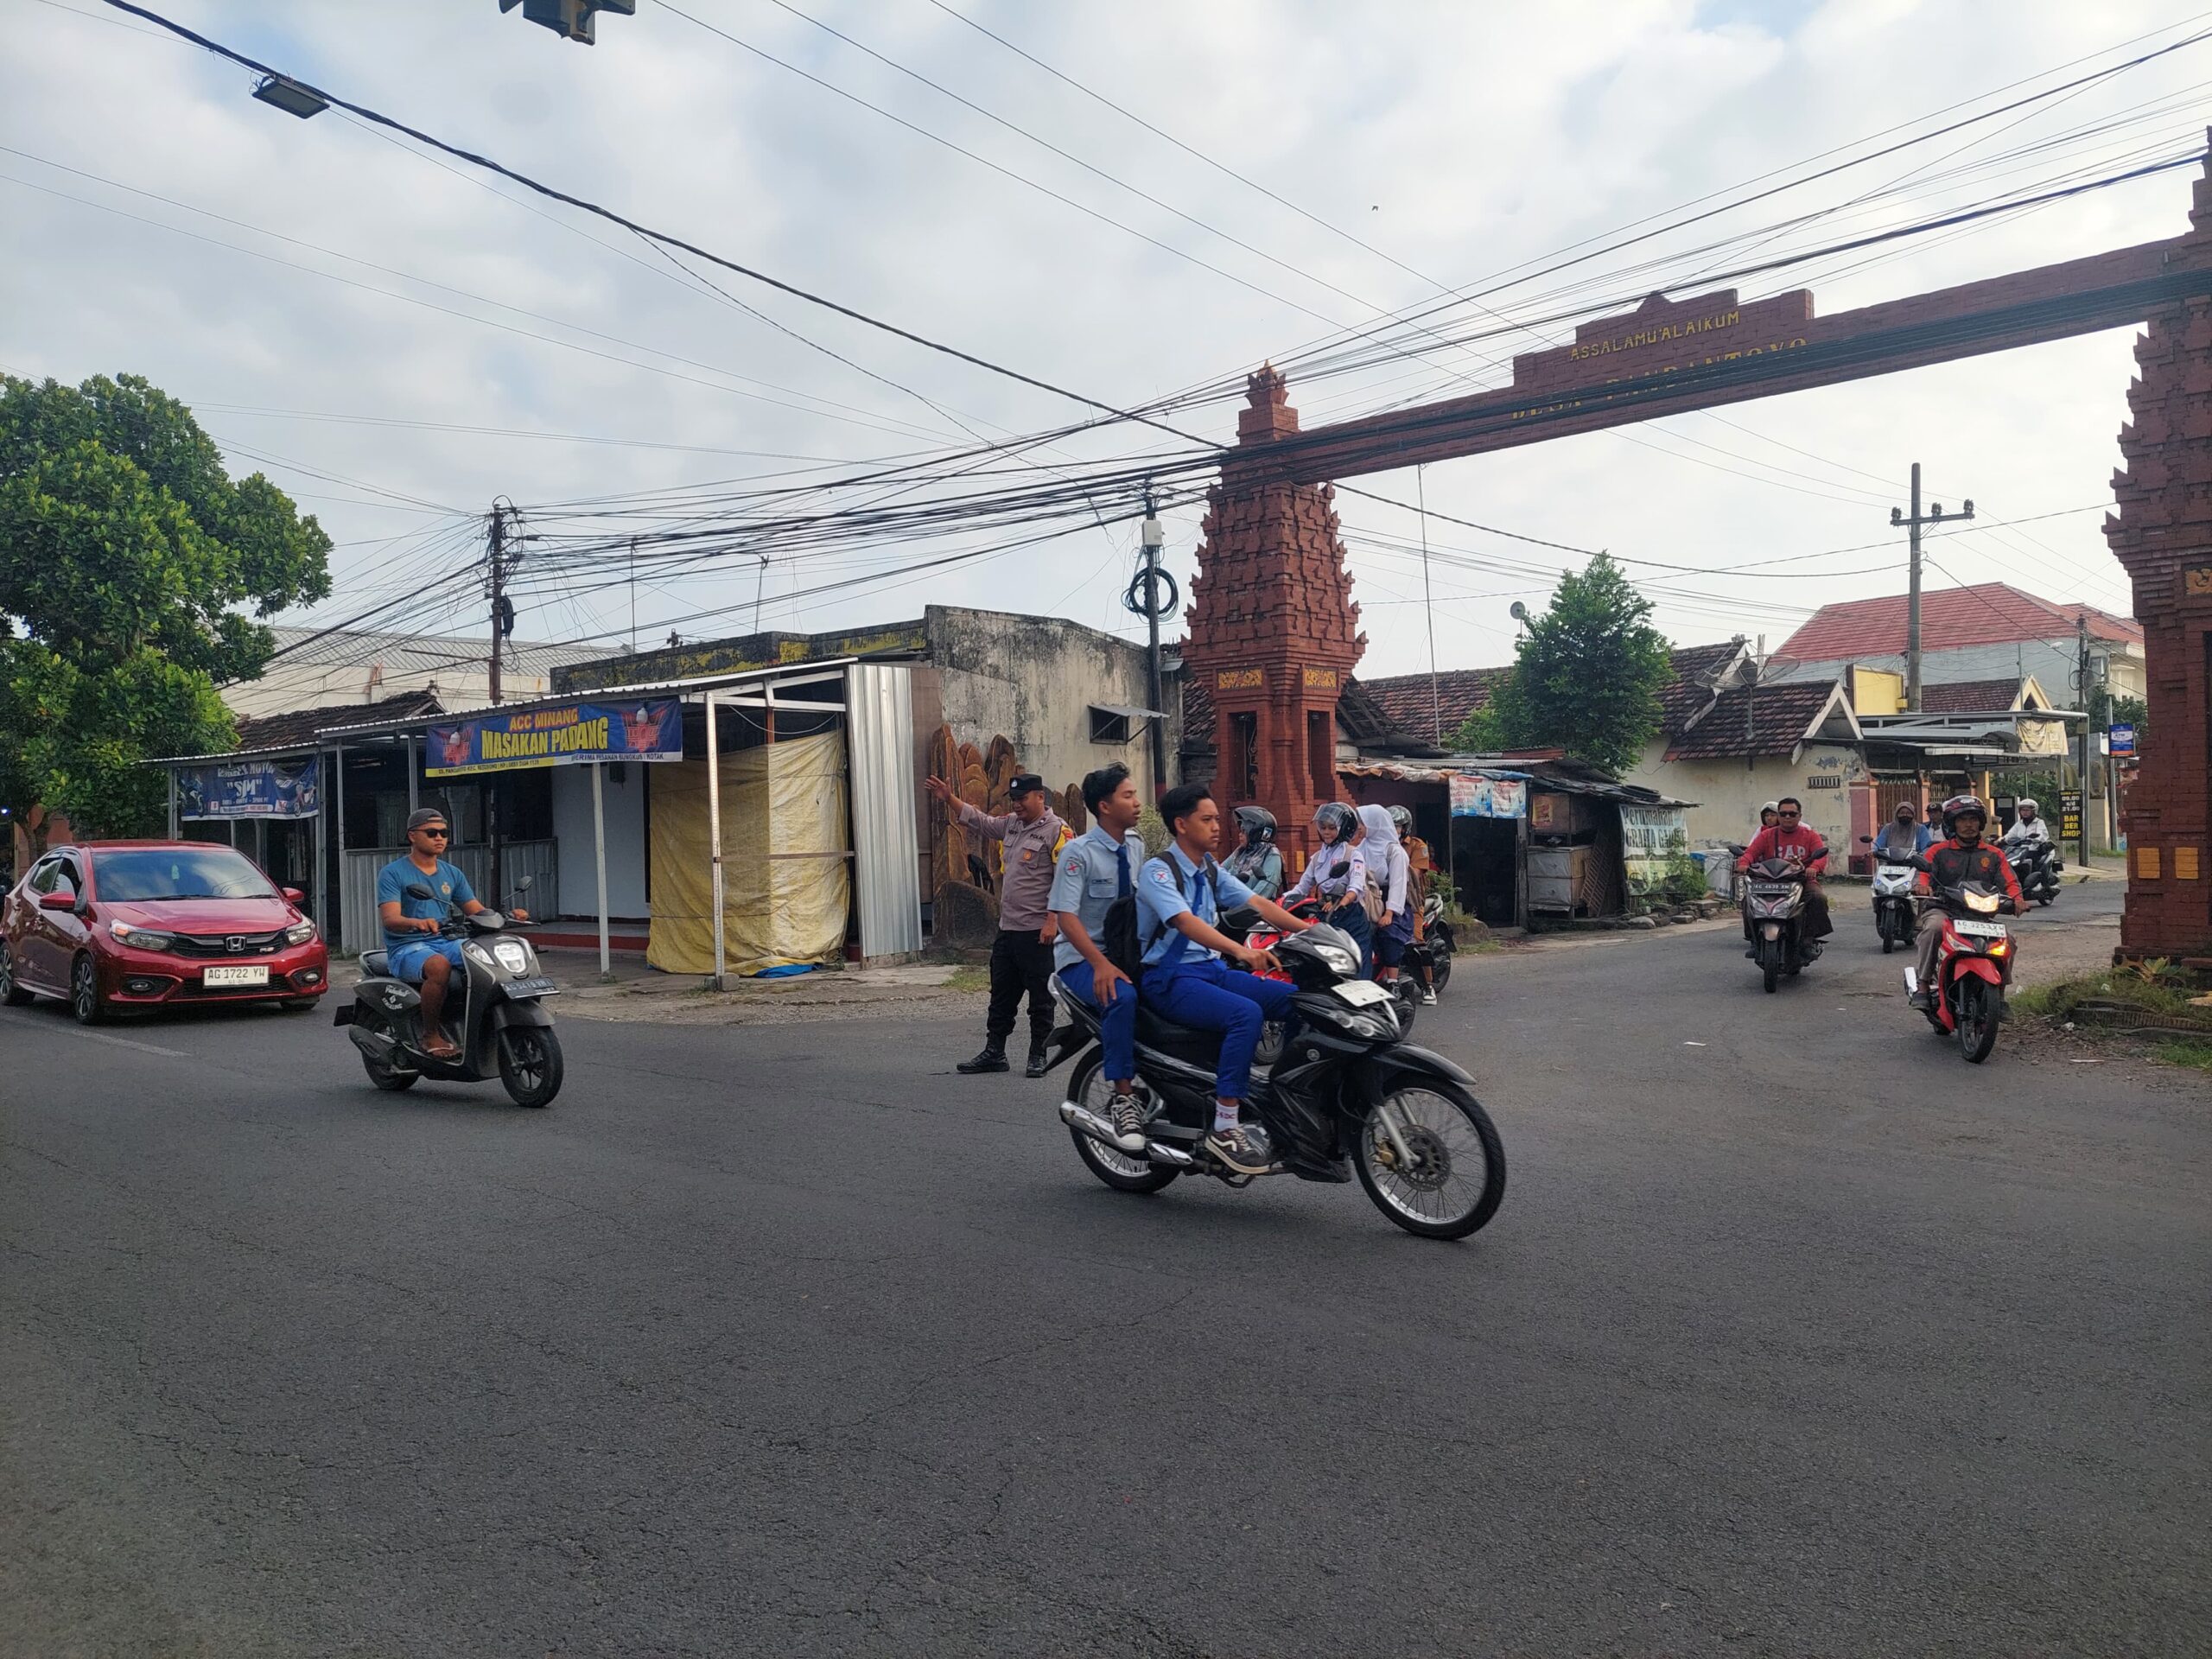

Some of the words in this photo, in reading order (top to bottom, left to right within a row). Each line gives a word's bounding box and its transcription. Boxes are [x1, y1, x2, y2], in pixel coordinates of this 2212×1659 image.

[1569, 311, 1740, 361] ASSALAMU'ALAIKUM
[509, 715, 531, 731] ACC
[534, 709, 578, 728] MINANG
[481, 731, 549, 760] MASAKAN
[551, 716, 608, 753] PADANG
[1623, 804, 1674, 827] Perumahan
[207, 969, 221, 979] AG
[223, 968, 249, 978] 1722
[252, 967, 265, 977] YW
